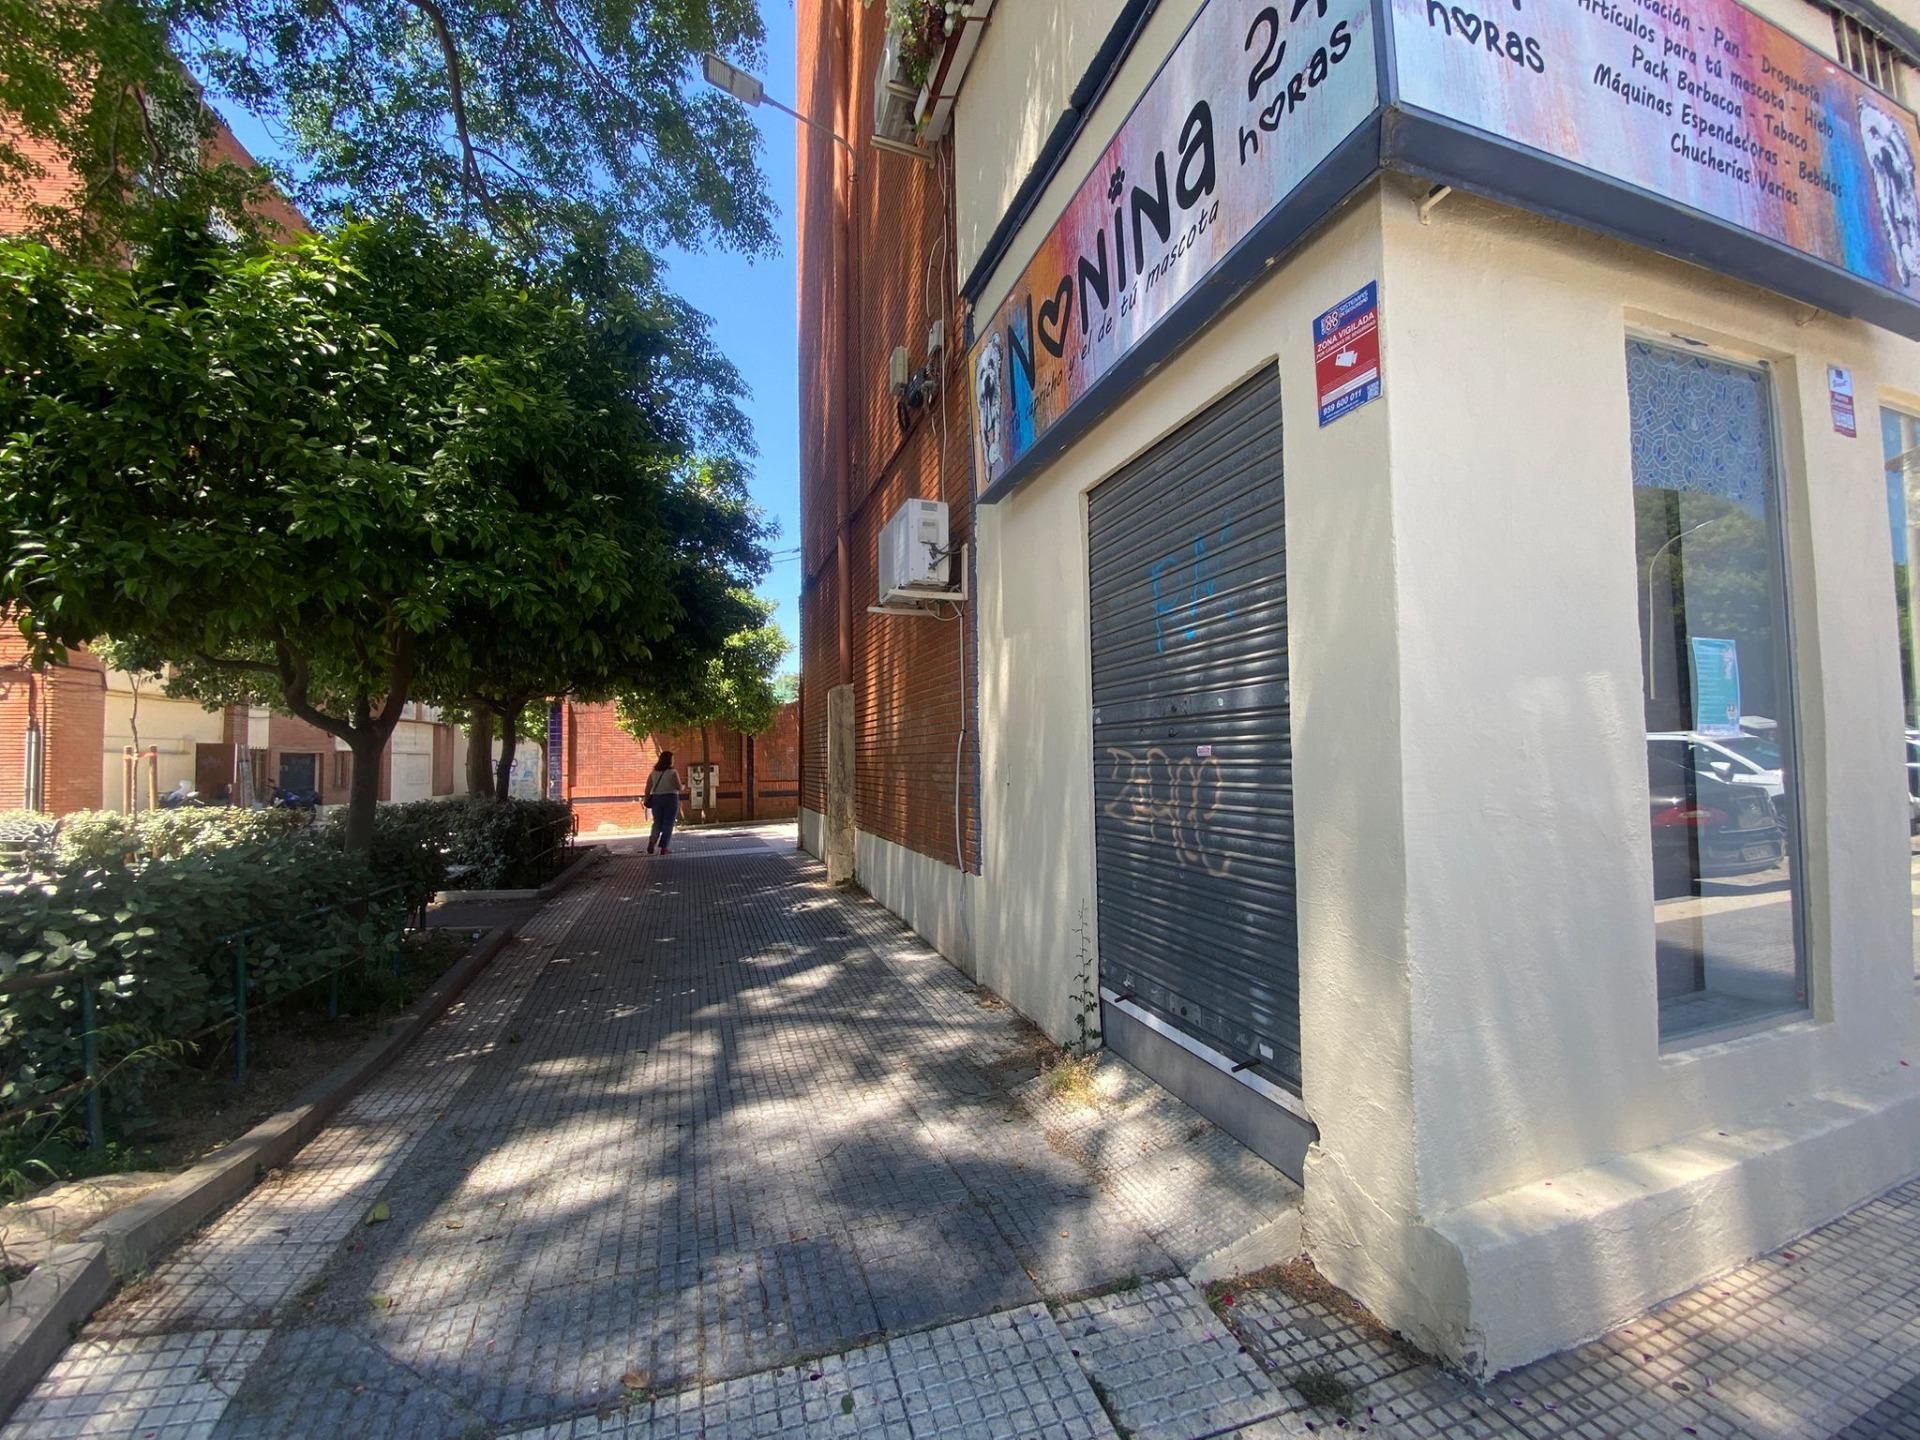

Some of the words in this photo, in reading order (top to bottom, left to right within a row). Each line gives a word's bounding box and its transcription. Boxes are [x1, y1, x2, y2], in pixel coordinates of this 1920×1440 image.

[1244, 0, 1328, 102] 2
[1632, 44, 1668, 84] Pack
[1677, 71, 1742, 119] Barbacoa
[1764, 114, 1808, 151] Tabaco
[1664, 37, 1697, 65] para
[1705, 55, 1722, 79] tú
[1730, 71, 1785, 111] mascota
[1804, 107, 1833, 138] Hielo
[1714, 27, 1739, 58] Pan
[1761, 55, 1820, 103] Droguería
[1593, 63, 1672, 117] Máquinas
[1798, 160, 1843, 198] Bebidas
[1671, 133, 1751, 184] Chucherías
[1758, 171, 1799, 205] Varias
[1068, 355, 1075, 381] y
[1081, 330, 1093, 360] el
[1097, 313, 1112, 343] de
[1120, 282, 1137, 317] tú
[1146, 200, 1219, 293] mascota
[1317, 334, 1337, 352] ZONA
[1338, 311, 1375, 340] VIGILADA
[1323, 403, 1335, 417] 959
[1336, 396, 1349, 410] 600
[1350, 389, 1362, 402] 011
